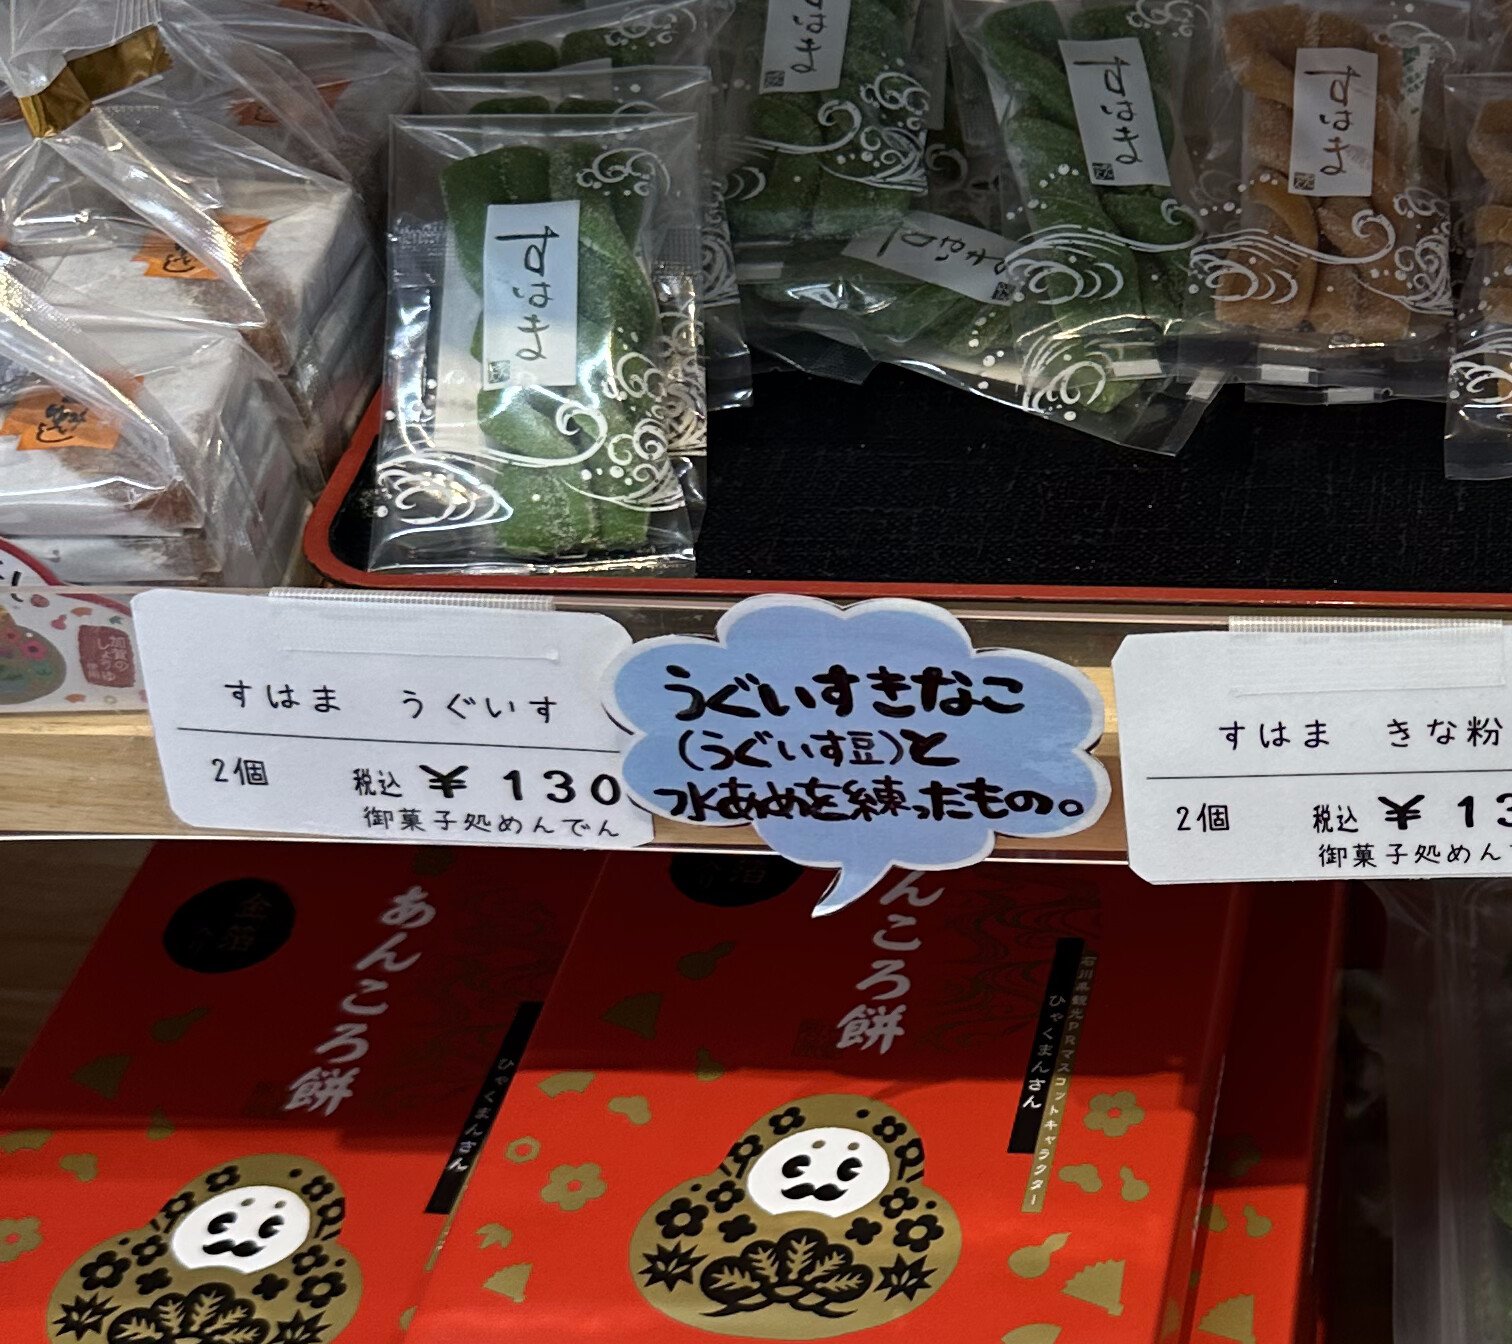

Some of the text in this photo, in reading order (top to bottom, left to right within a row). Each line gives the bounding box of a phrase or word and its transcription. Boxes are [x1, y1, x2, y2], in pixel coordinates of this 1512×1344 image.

[1072, 56, 1140, 167] すはま
[1302, 66, 1363, 176] すはま
[495, 223, 560, 363] すはま
[224, 680, 557, 723] すはま うぐいす
[663, 664, 1025, 720] うぐいすきなこ
[1219, 716, 1503, 750] すはま きな粉
[212, 758, 269, 787] 2個
[353, 768, 403, 799] 税込
[653, 775, 1085, 821] 水あめを練ったもの。
[363, 808, 620, 838] 御菓子処めんでん
[1176, 803, 1230, 833] 2個
[1313, 804, 1359, 833] 税込
[835, 870, 944, 1055] んころ餅
[284, 884, 437, 1117] あんころ餅
